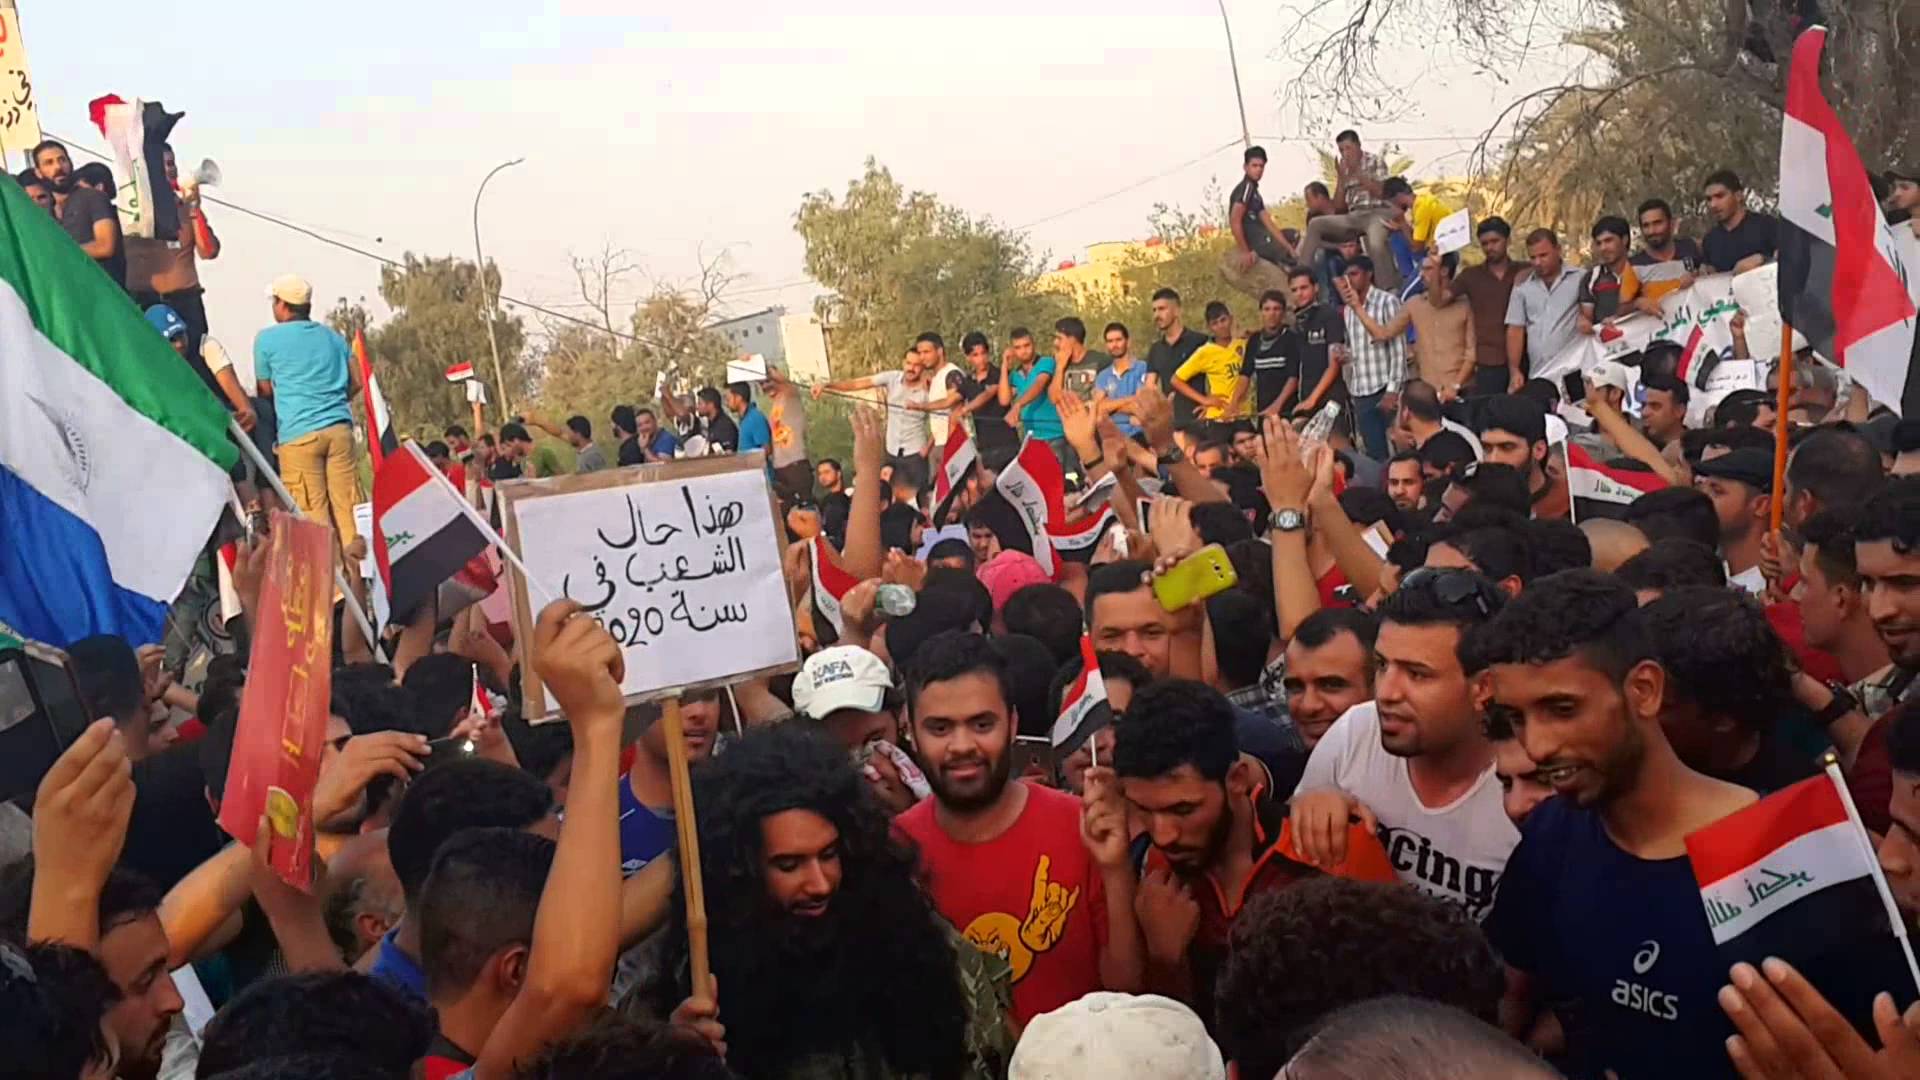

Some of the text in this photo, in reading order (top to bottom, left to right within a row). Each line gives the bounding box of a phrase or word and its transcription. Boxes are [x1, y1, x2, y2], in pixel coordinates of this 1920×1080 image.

[597, 485, 744, 549] هذا حال
[563, 555, 616, 616] في
[669, 590, 748, 632] سنة
[1611, 979, 1679, 1020] asics
